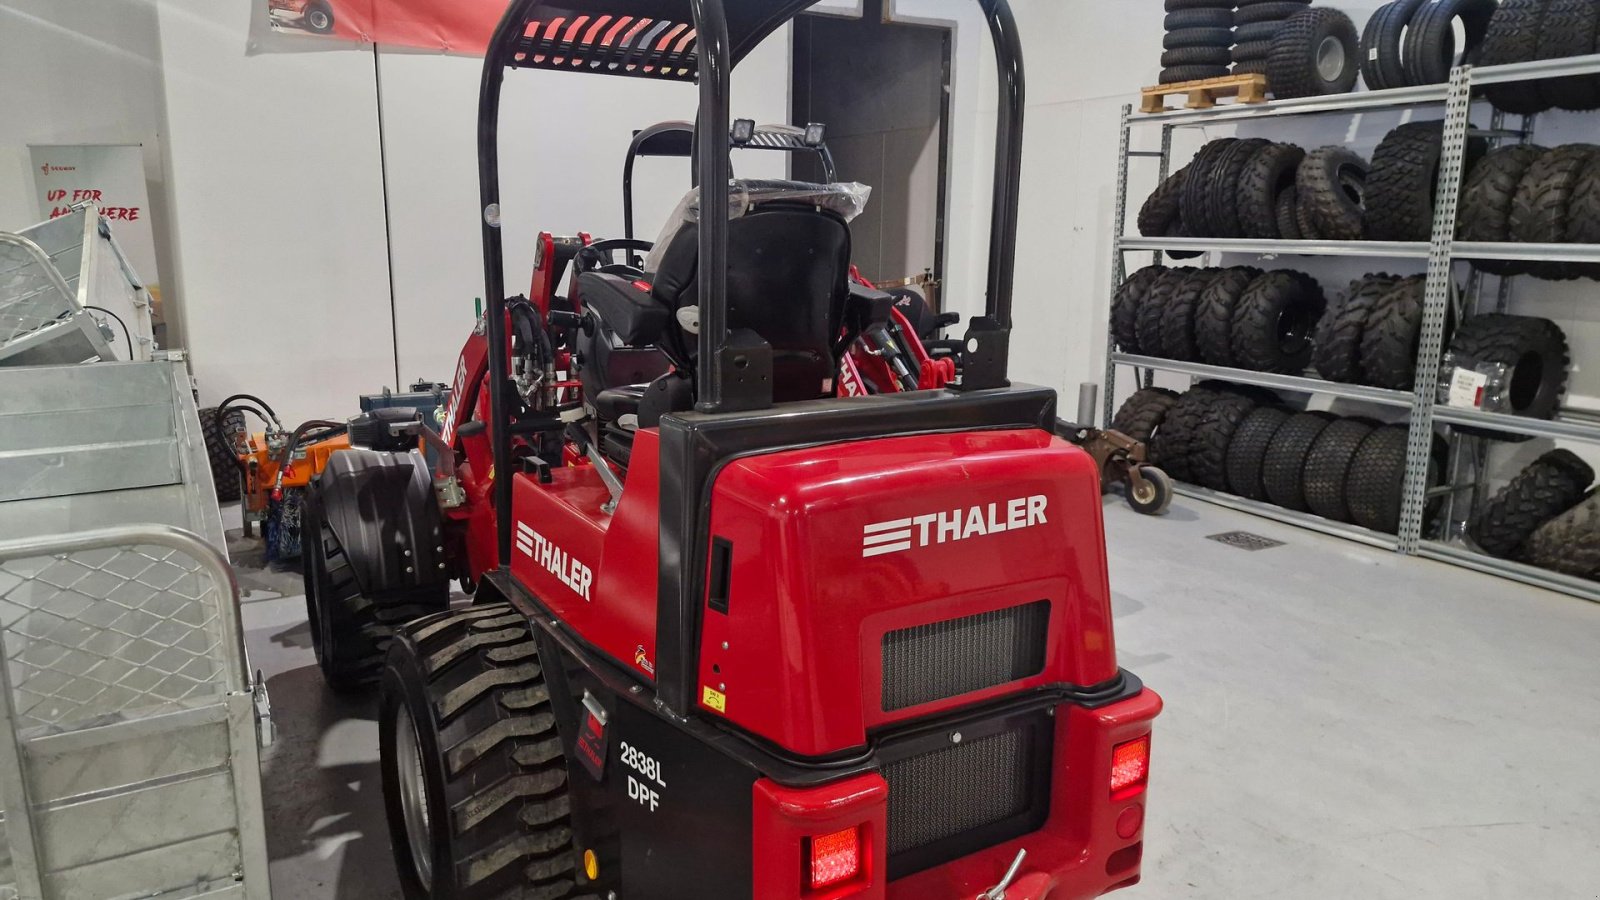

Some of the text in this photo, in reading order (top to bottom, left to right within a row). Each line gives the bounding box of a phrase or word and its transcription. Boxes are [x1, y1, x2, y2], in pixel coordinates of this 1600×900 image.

[47, 189, 102, 202] UP FOR
[913, 494, 1048, 547] THALER
[533, 529, 593, 602] THALER
[620, 741, 667, 788] 2838L
[627, 775, 660, 812] DPF
